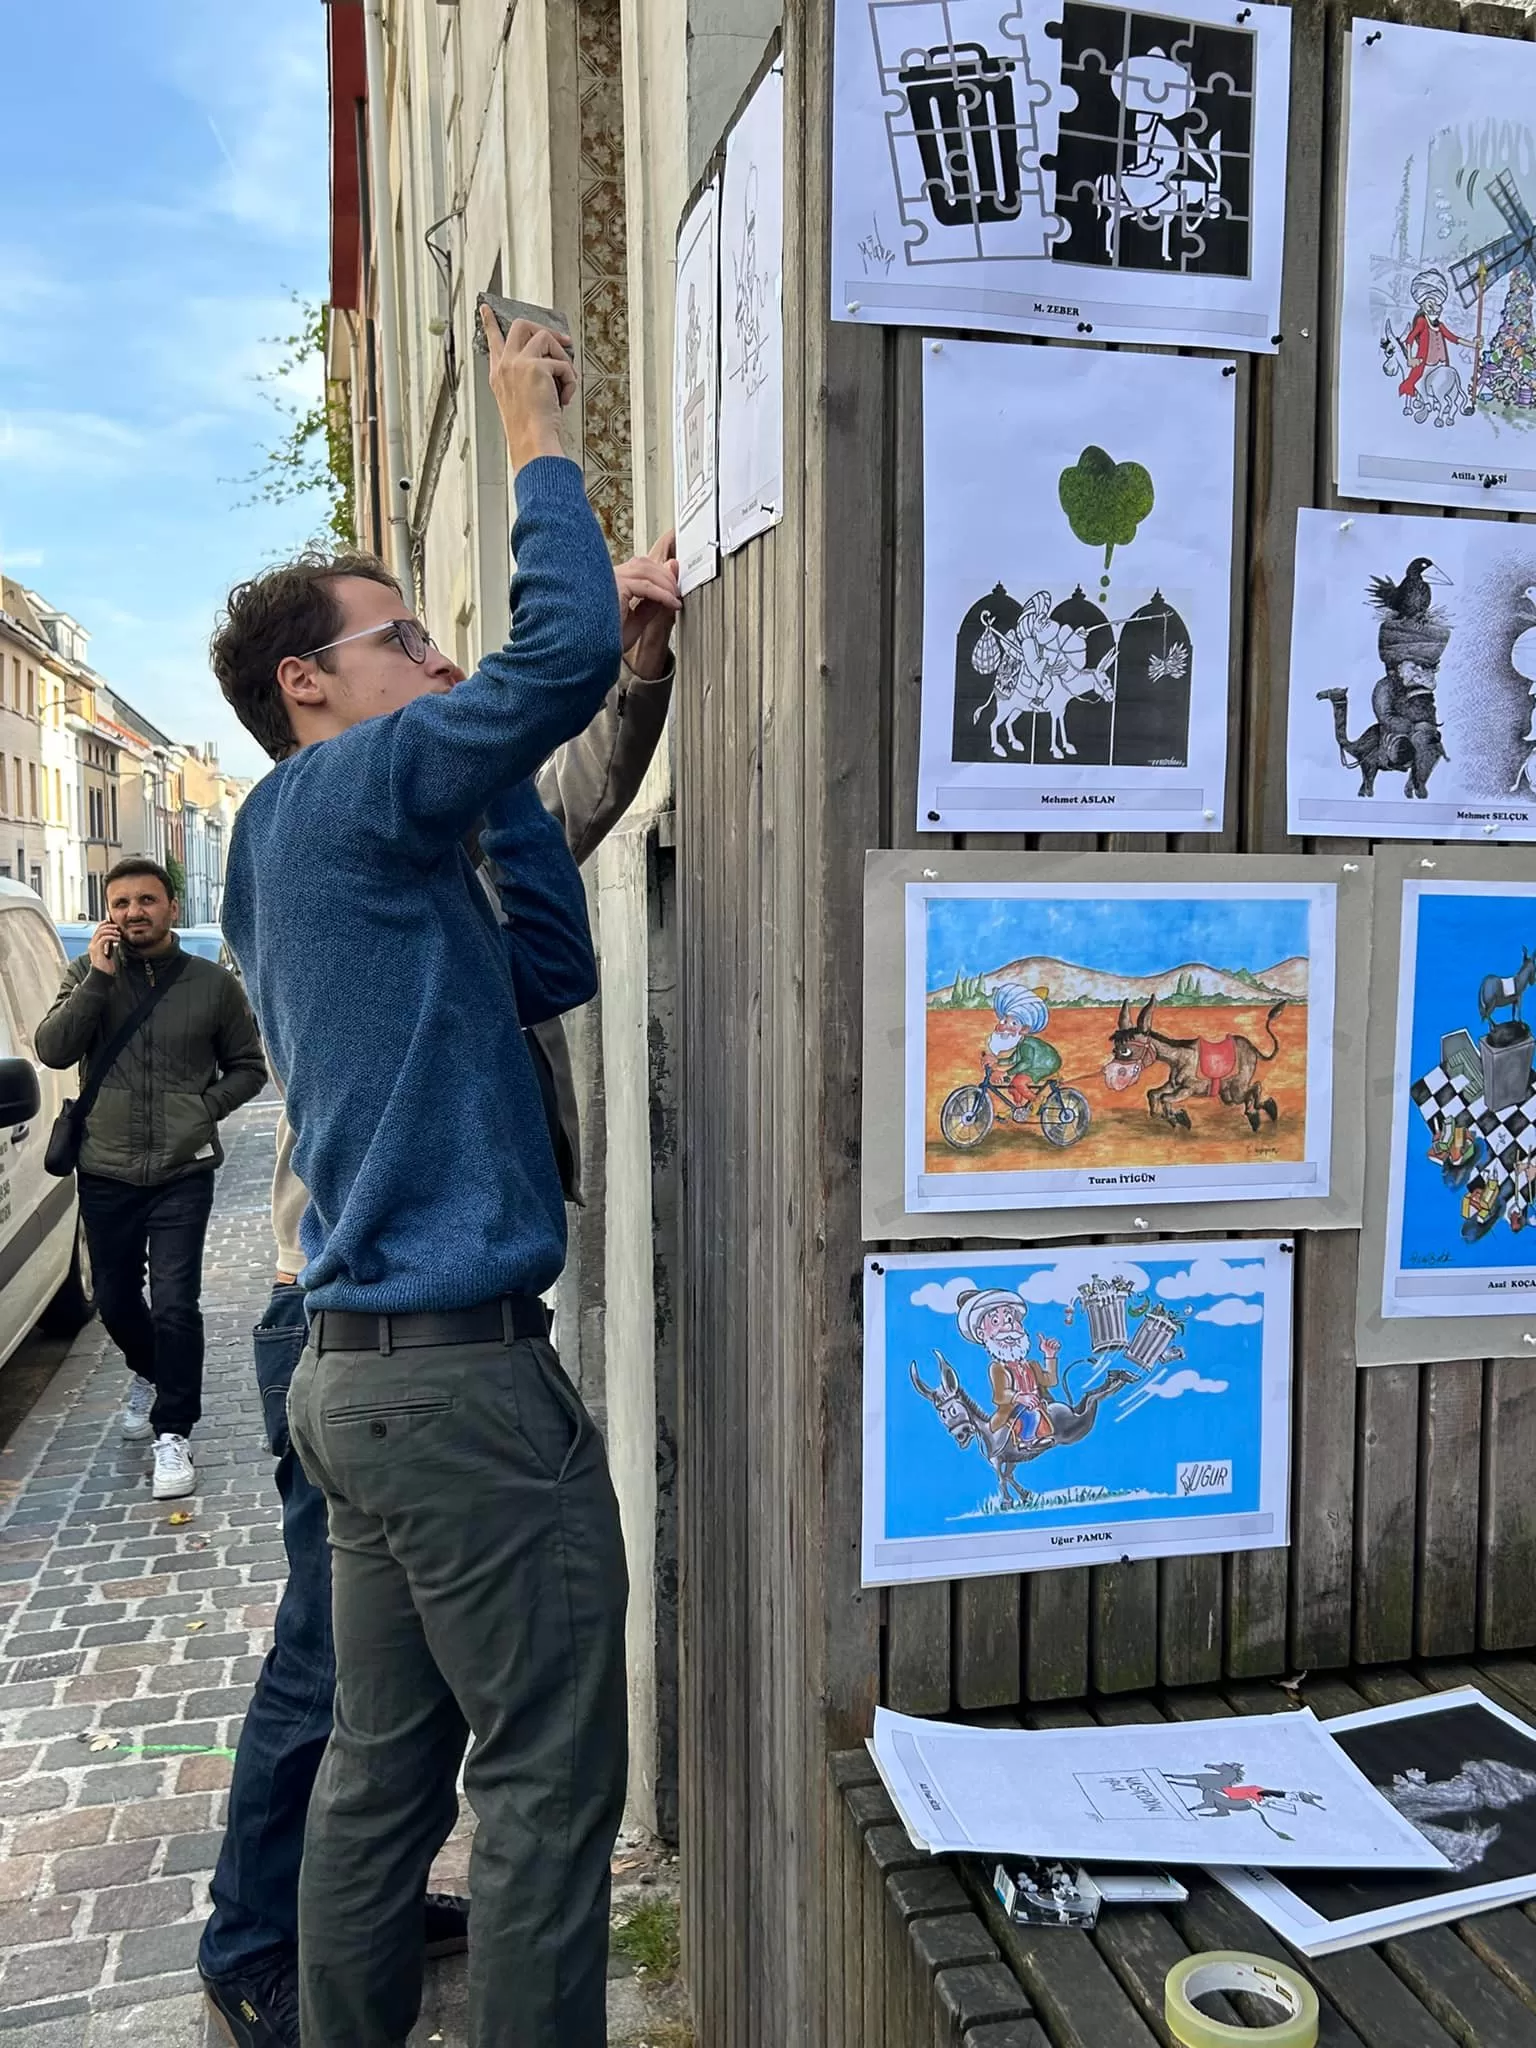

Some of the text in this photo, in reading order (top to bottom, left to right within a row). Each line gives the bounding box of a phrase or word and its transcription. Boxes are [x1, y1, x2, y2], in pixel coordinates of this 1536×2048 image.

[1034, 303, 1080, 316] M. ZEBER
[1451, 471, 1476, 481] Atilla
[1041, 795, 1116, 804] Mehmet ASLAN
[1456, 811, 1529, 822] Mehmet SELÇUK
[1088, 1176, 1117, 1185] Turan
[1050, 1532, 1113, 1546] Uğur PAMUK
